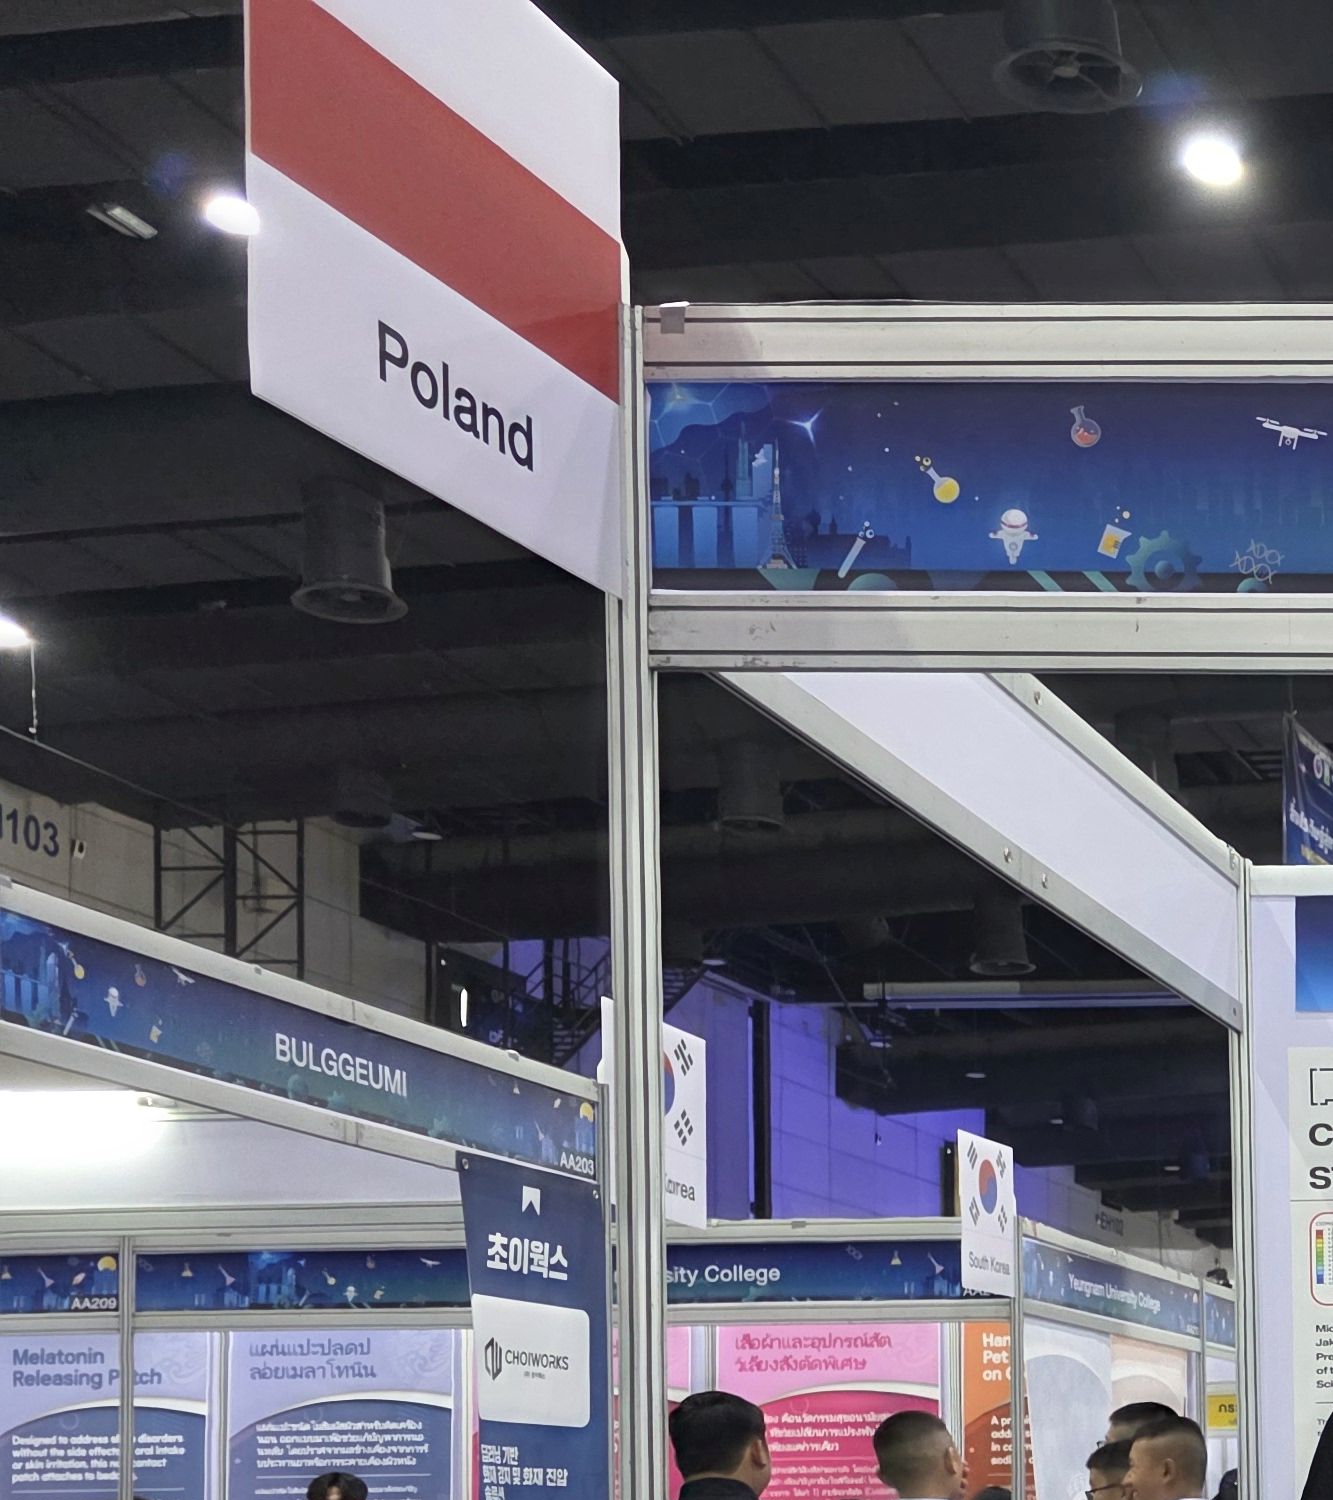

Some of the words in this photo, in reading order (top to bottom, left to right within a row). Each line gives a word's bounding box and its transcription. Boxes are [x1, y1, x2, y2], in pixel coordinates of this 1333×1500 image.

[378, 319, 533, 472] Poland
[275, 1032, 408, 1097] BULGGEUMI
[560, 1151, 595, 1176] AA203
[486, 1232, 568, 1281] 초이웍스
[969, 1251, 989, 1271] South
[705, 1264, 781, 1286] College
[71, 1297, 118, 1310] AA209
[13, 1347, 105, 1366] Melatonin
[505, 1349, 569, 1371] CHOIWORKS
[13, 1369, 103, 1390] Releasing
[109, 1368, 162, 1386] Ptch
[982, 1369, 1002, 1381] on
[1316, 1366, 1328, 1375] of
[12, 1435, 56, 1447] Designed
[59, 1435, 68, 1445] to
[70, 1434, 109, 1445] address
[12, 1448, 48, 1458] without
[50, 1448, 64, 1457] the
[67, 1447, 87, 1457] side
[156, 1446, 186, 1455] intake
[12, 1461, 24, 1470] or
[25, 1459, 44, 1470] skin
[90, 1459, 108, 1469] this
[12, 1472, 39, 1484] patch
[41, 1472, 83, 1481] attaches
[85, 1472, 95, 1481] to
[522, 1467, 544, 1486] 화재
[546, 1467, 568, 1487] 진압
